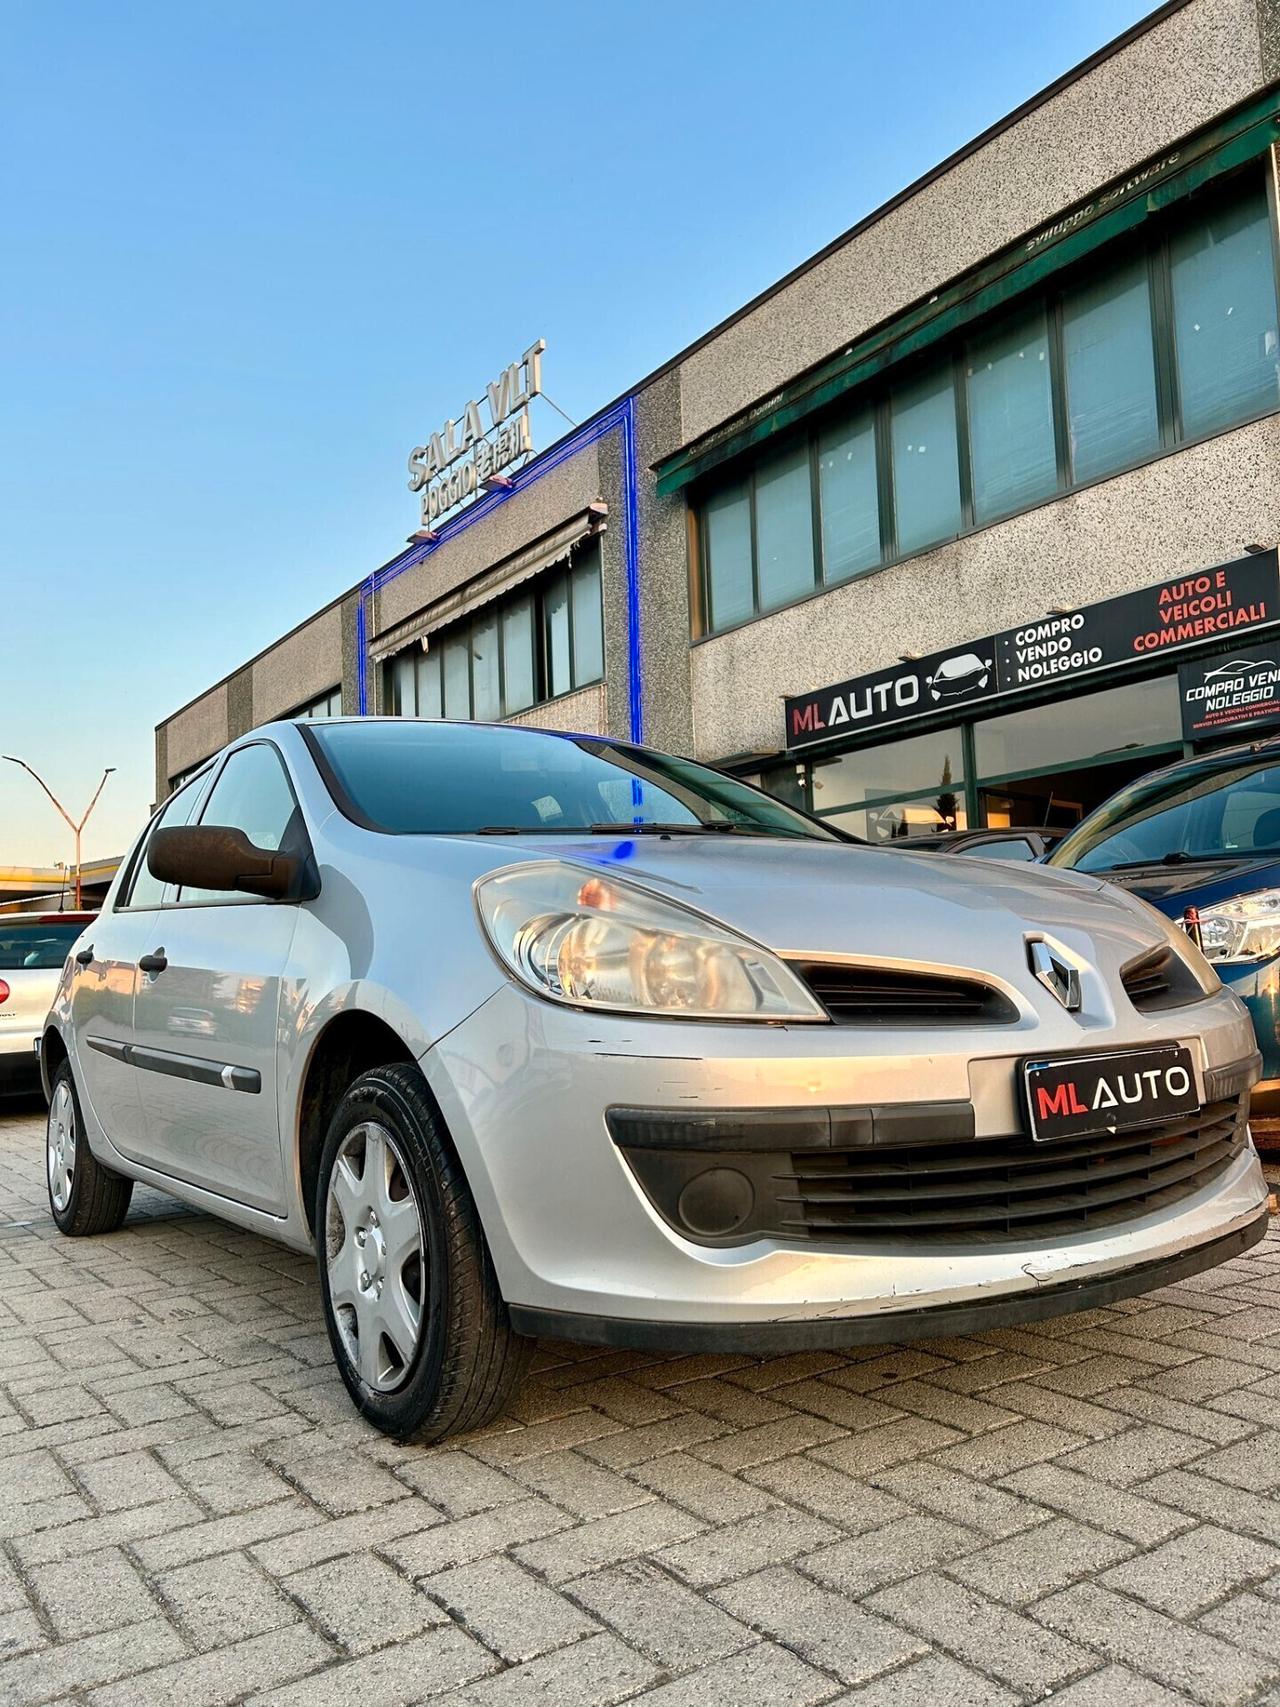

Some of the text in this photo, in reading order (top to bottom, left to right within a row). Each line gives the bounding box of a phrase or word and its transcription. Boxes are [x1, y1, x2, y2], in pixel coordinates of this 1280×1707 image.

[1025, 203, 1095, 252] Sviluppo
[408, 337, 546, 492] SALA VLT
[420, 460, 478, 526] POGGIO
[1158, 570, 1226, 606] AUTO E
[1159, 590, 1233, 625] VEICOLI
[1015, 613, 1085, 648] COMPRO
[1133, 602, 1267, 653] COMMERCIALI
[1016, 636, 1072, 664] VENDO
[1017, 646, 1103, 683] NOLEGGIO
[1185, 676, 1245, 702] COMPRO
[1205, 685, 1275, 712] NOLEGGIO
[1245, 699, 1280, 710] COMMERCIAL
[1092, 1066, 1190, 1110] AUTO
